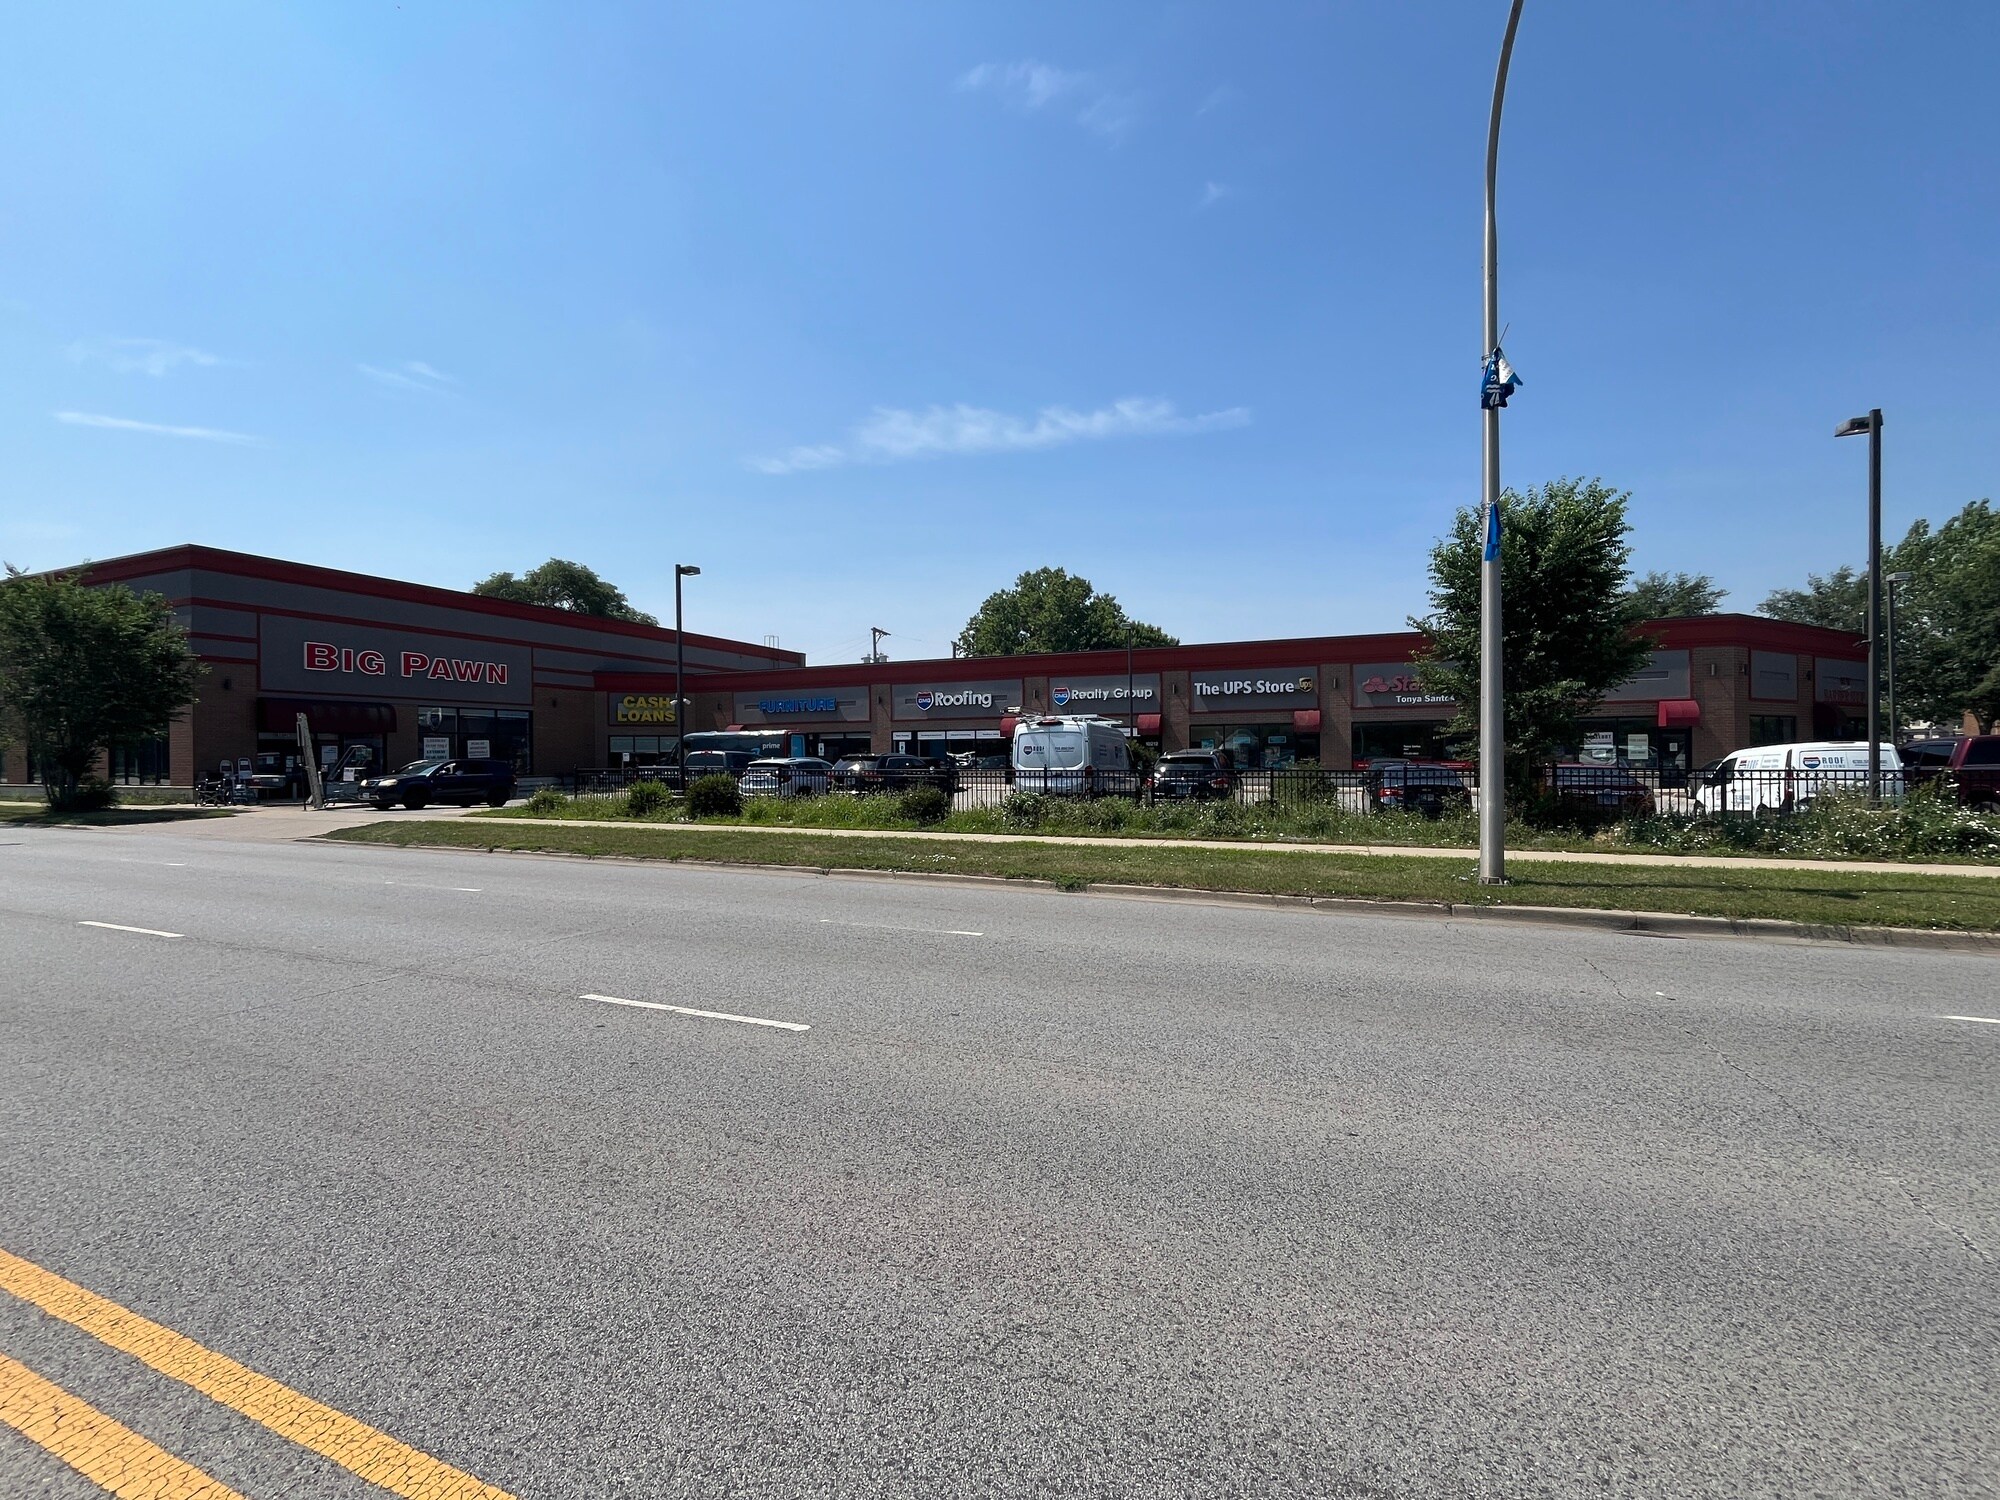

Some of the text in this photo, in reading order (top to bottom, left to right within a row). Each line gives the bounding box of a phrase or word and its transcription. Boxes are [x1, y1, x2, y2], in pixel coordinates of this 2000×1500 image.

[303, 641, 508, 686] BIG PAWN
[1071, 688, 1110, 701] Realty
[1113, 687, 1153, 700] Group
[1194, 682, 1220, 695] The
[1223, 681, 1252, 695] UPS
[1256, 680, 1294, 694] Store
[623, 694, 671, 709] CASH
[758, 695, 837, 714] FURNITURE
[935, 690, 993, 708] Roofing
[1395, 696, 1422, 704] Tonya
[617, 709, 676, 723] LOANS
[762, 742, 780, 751] prime
